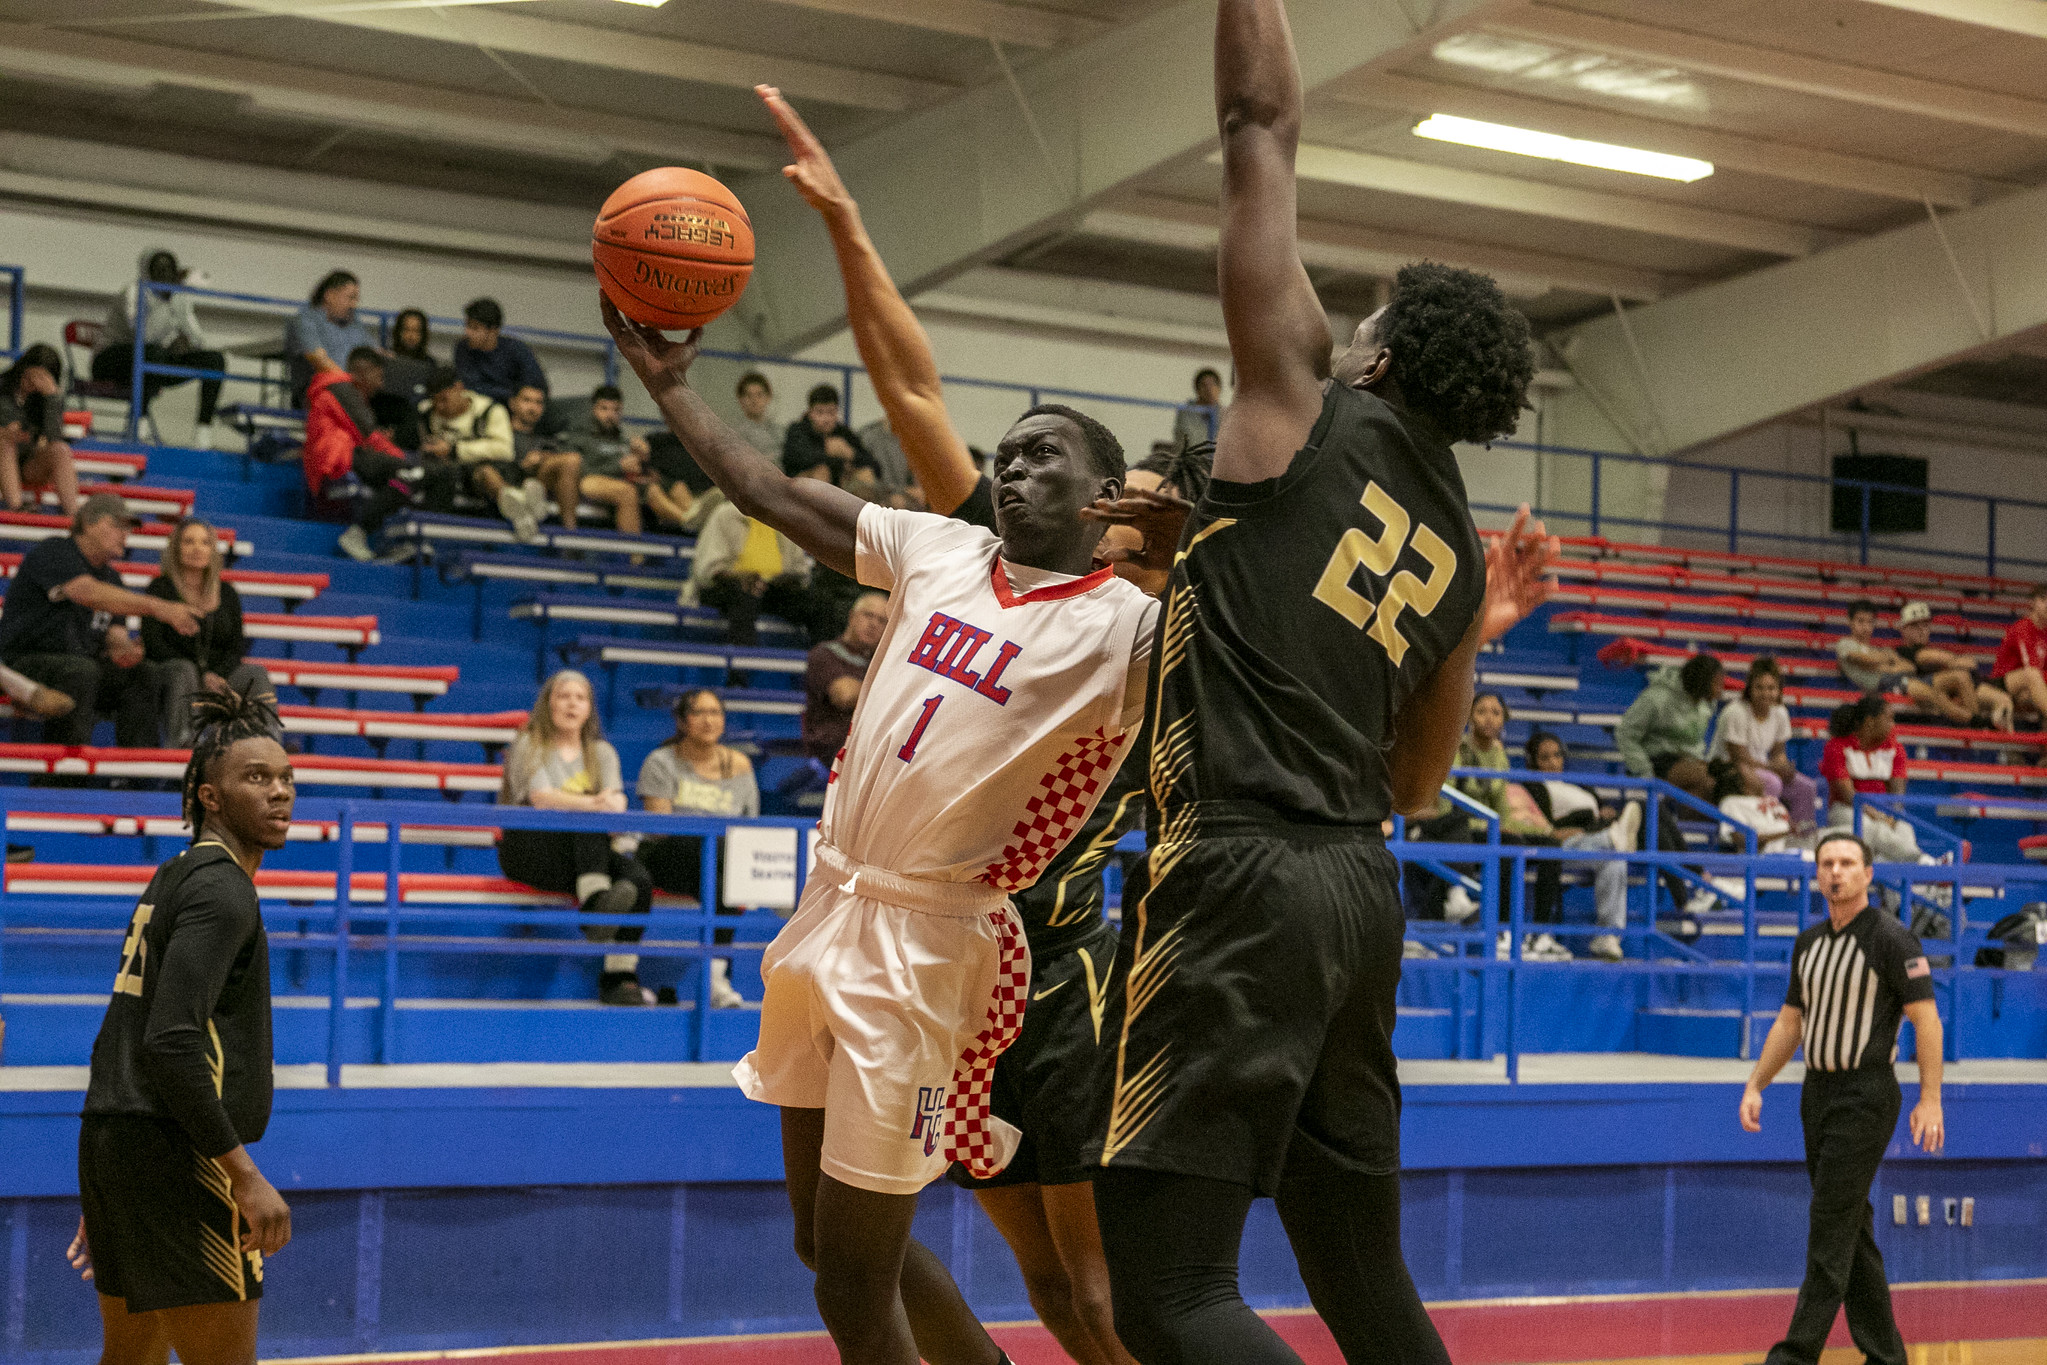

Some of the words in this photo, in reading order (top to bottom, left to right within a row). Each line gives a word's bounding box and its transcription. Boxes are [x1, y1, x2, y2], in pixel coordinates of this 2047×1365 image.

[644, 224, 735, 250] LEGACY
[634, 259, 738, 297] SPALDING
[1312, 479, 1458, 669] 22
[907, 611, 1023, 706] HILL
[897, 694, 945, 764] 1
